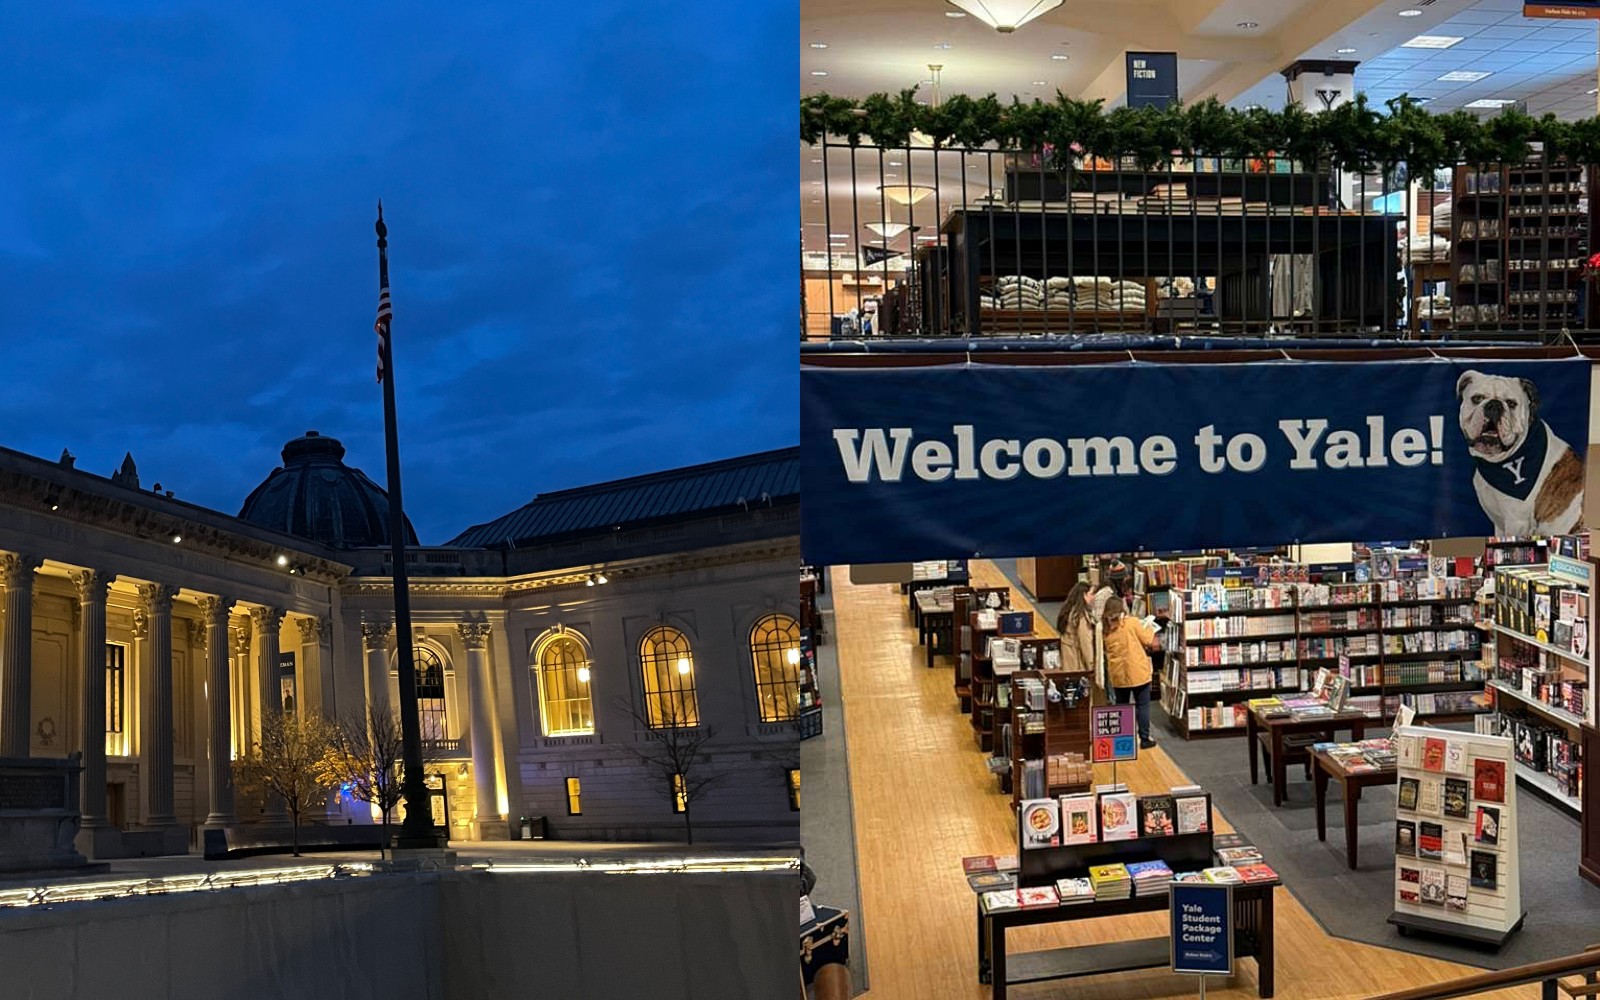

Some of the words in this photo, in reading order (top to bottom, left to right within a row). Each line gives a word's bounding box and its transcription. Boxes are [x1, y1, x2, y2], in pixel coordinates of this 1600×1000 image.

[1133, 59, 1146, 69] NEW
[1133, 69, 1156, 79] FICTION
[832, 424, 1178, 484] Welcome
[1194, 424, 1267, 473] to
[1278, 415, 1444, 470] Yale!
[1502, 456, 1526, 485] Y
[1110, 726, 1121, 734] OFF
[1182, 904, 1203, 913] Yale
[1182, 914, 1221, 923] Student
[1182, 924, 1222, 935] Package
[1182, 933, 1216, 943] Center
